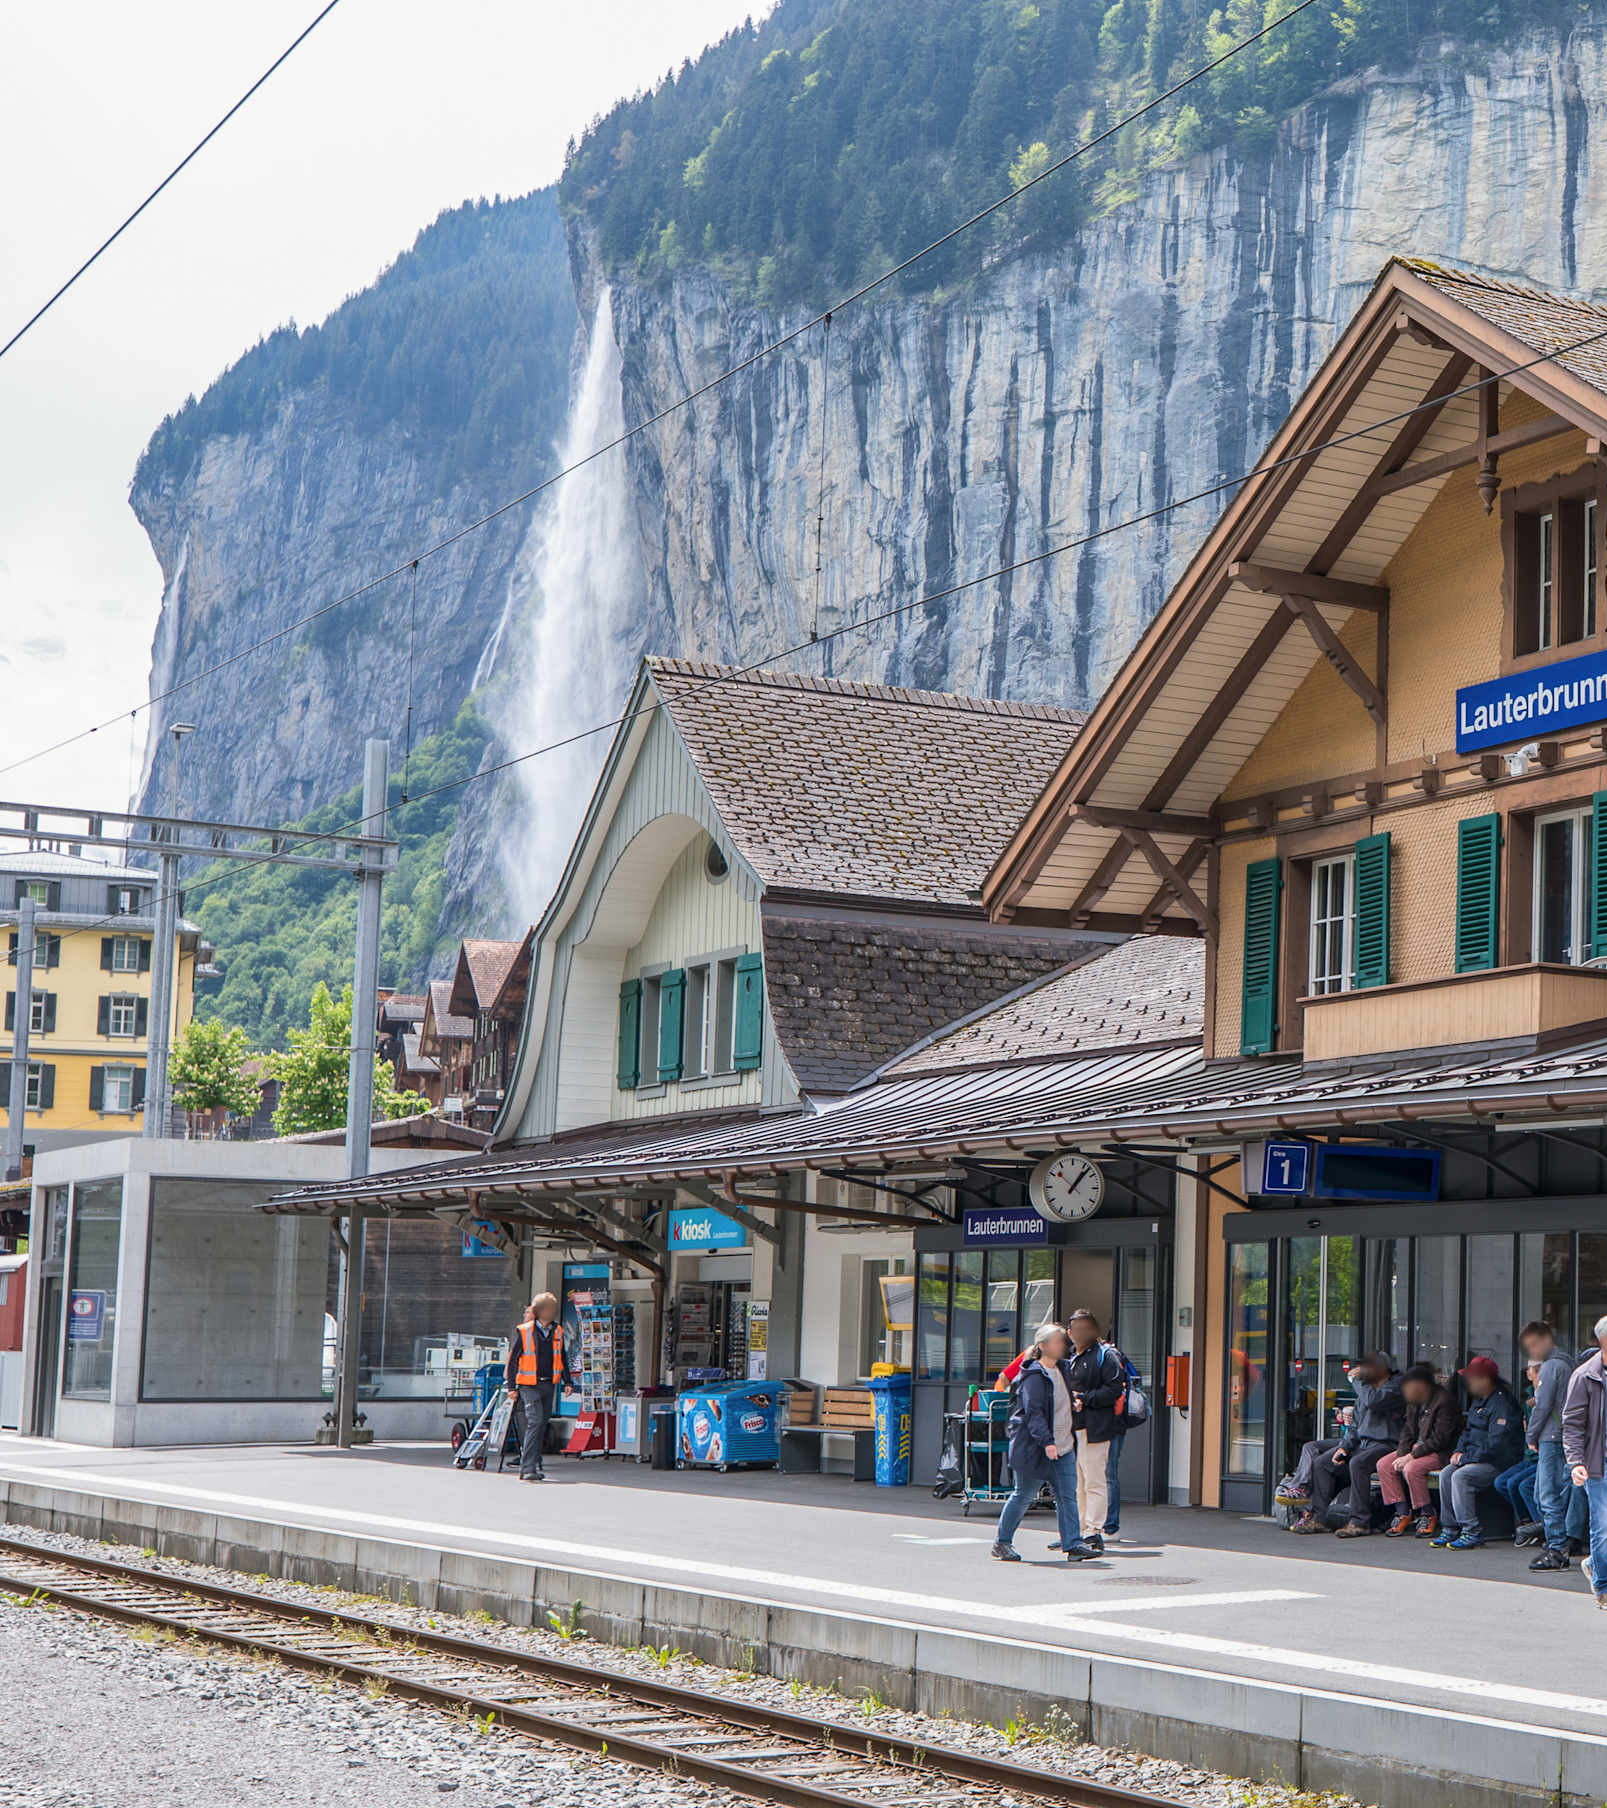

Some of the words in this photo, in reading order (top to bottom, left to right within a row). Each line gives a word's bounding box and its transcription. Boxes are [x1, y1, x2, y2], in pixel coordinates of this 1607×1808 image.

[1280, 1159, 1291, 1185] 1
[673, 1221, 681, 1240] k
[681, 1218, 712, 1241] kiosk
[967, 1216, 1044, 1236] Lauterbrunnen
